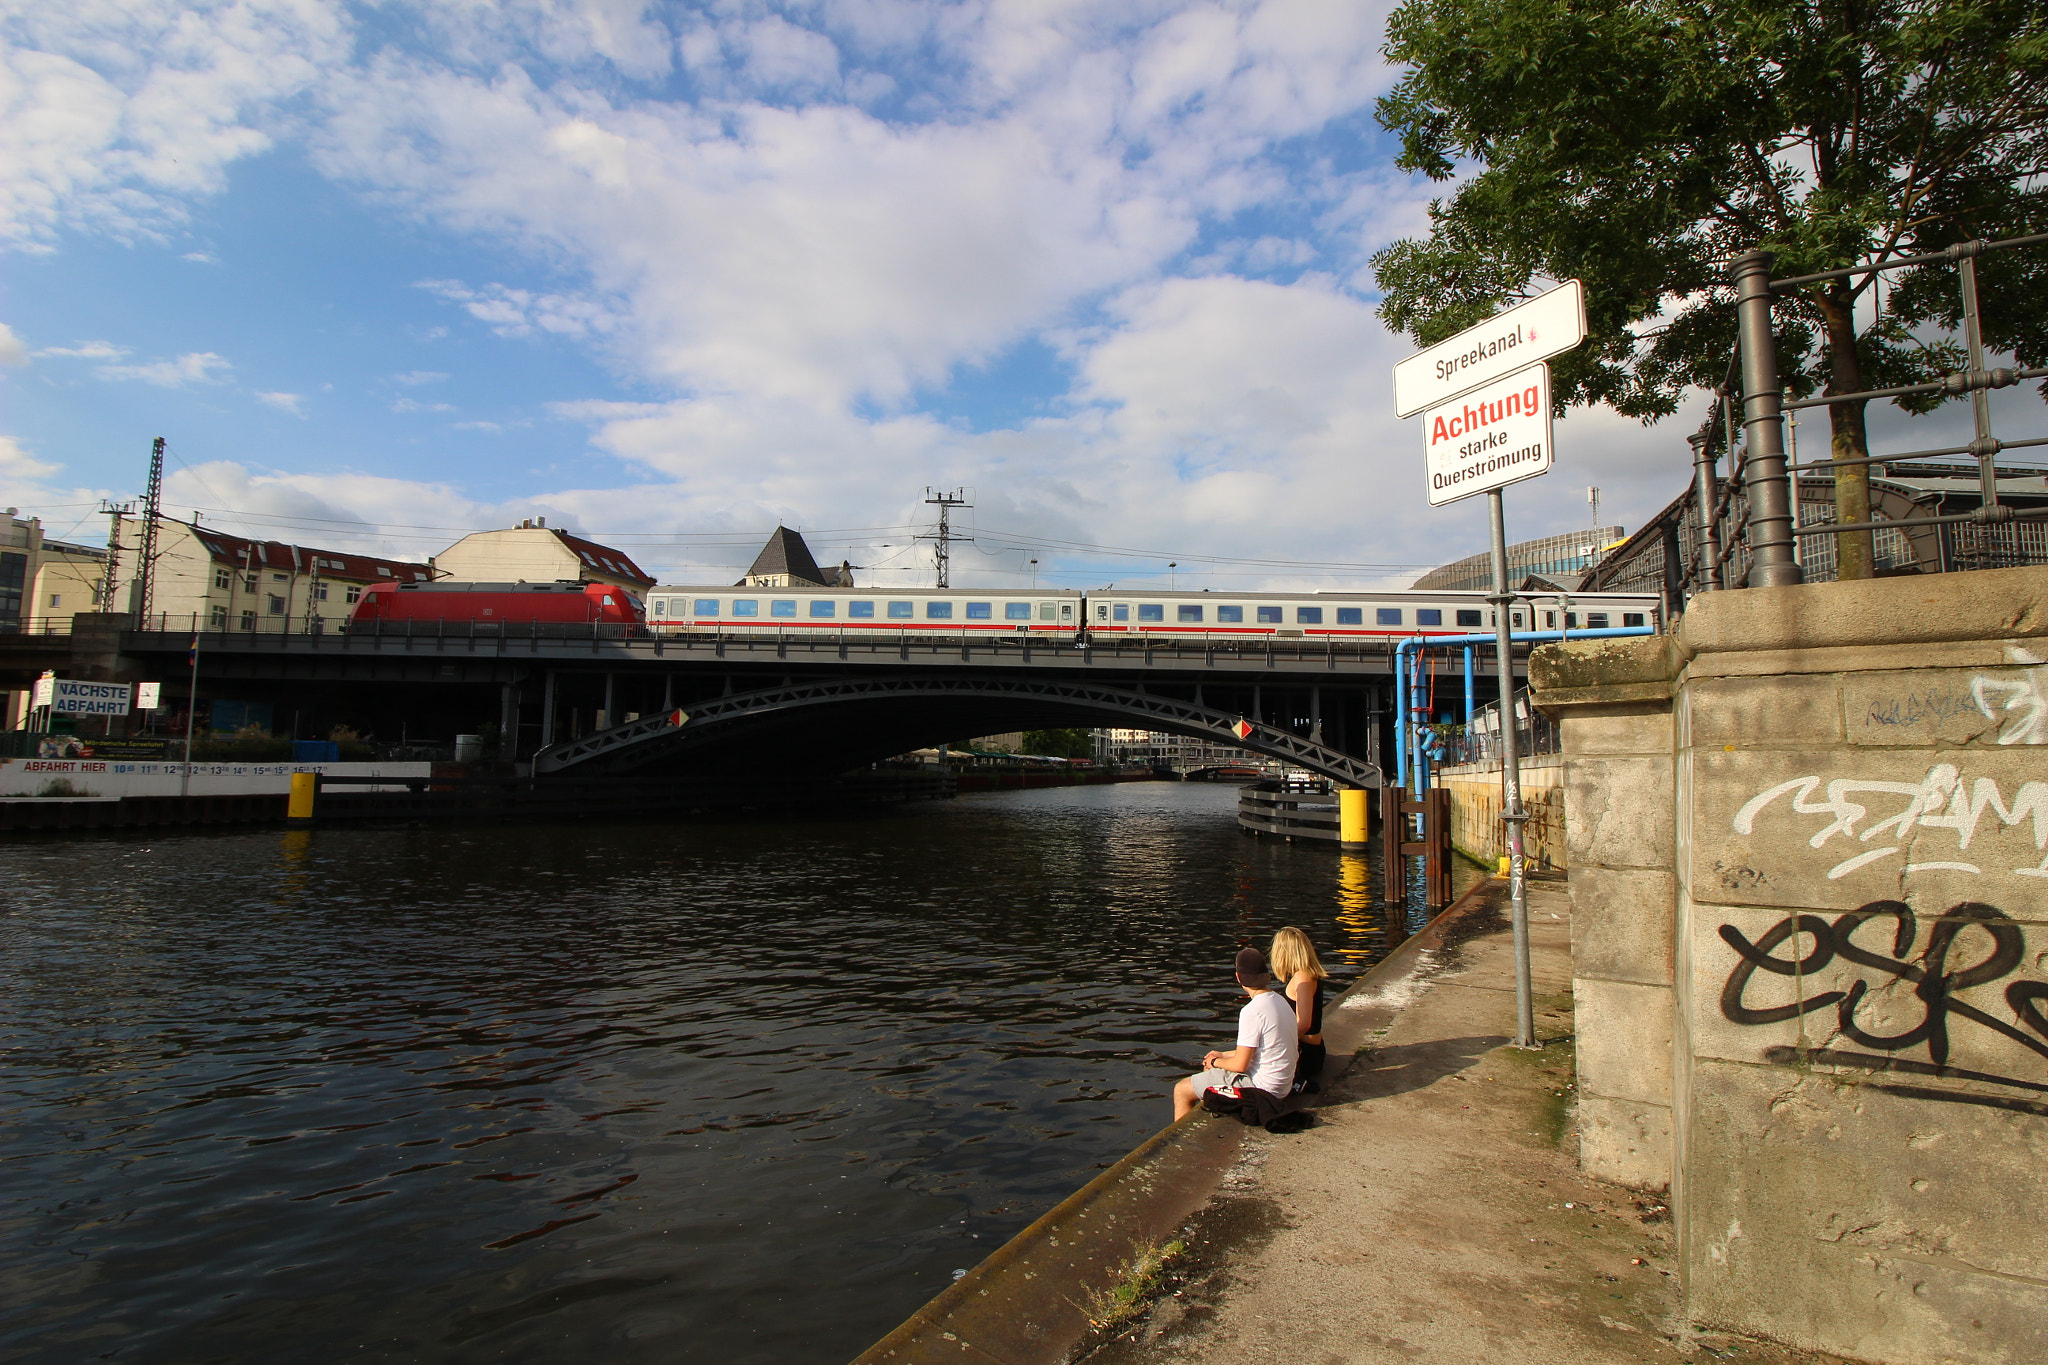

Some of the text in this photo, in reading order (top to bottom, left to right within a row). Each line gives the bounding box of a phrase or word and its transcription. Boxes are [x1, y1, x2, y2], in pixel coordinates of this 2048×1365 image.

[1436, 324, 1523, 381] Spreekanal
[1431, 385, 1539, 446] Achtung
[1459, 431, 1508, 459] starke
[1433, 443, 1541, 489] Querströmung
[57, 699, 126, 714] ABFAHRT
[24, 761, 76, 772] ABFAHRT
[81, 762, 106, 772] HIER
